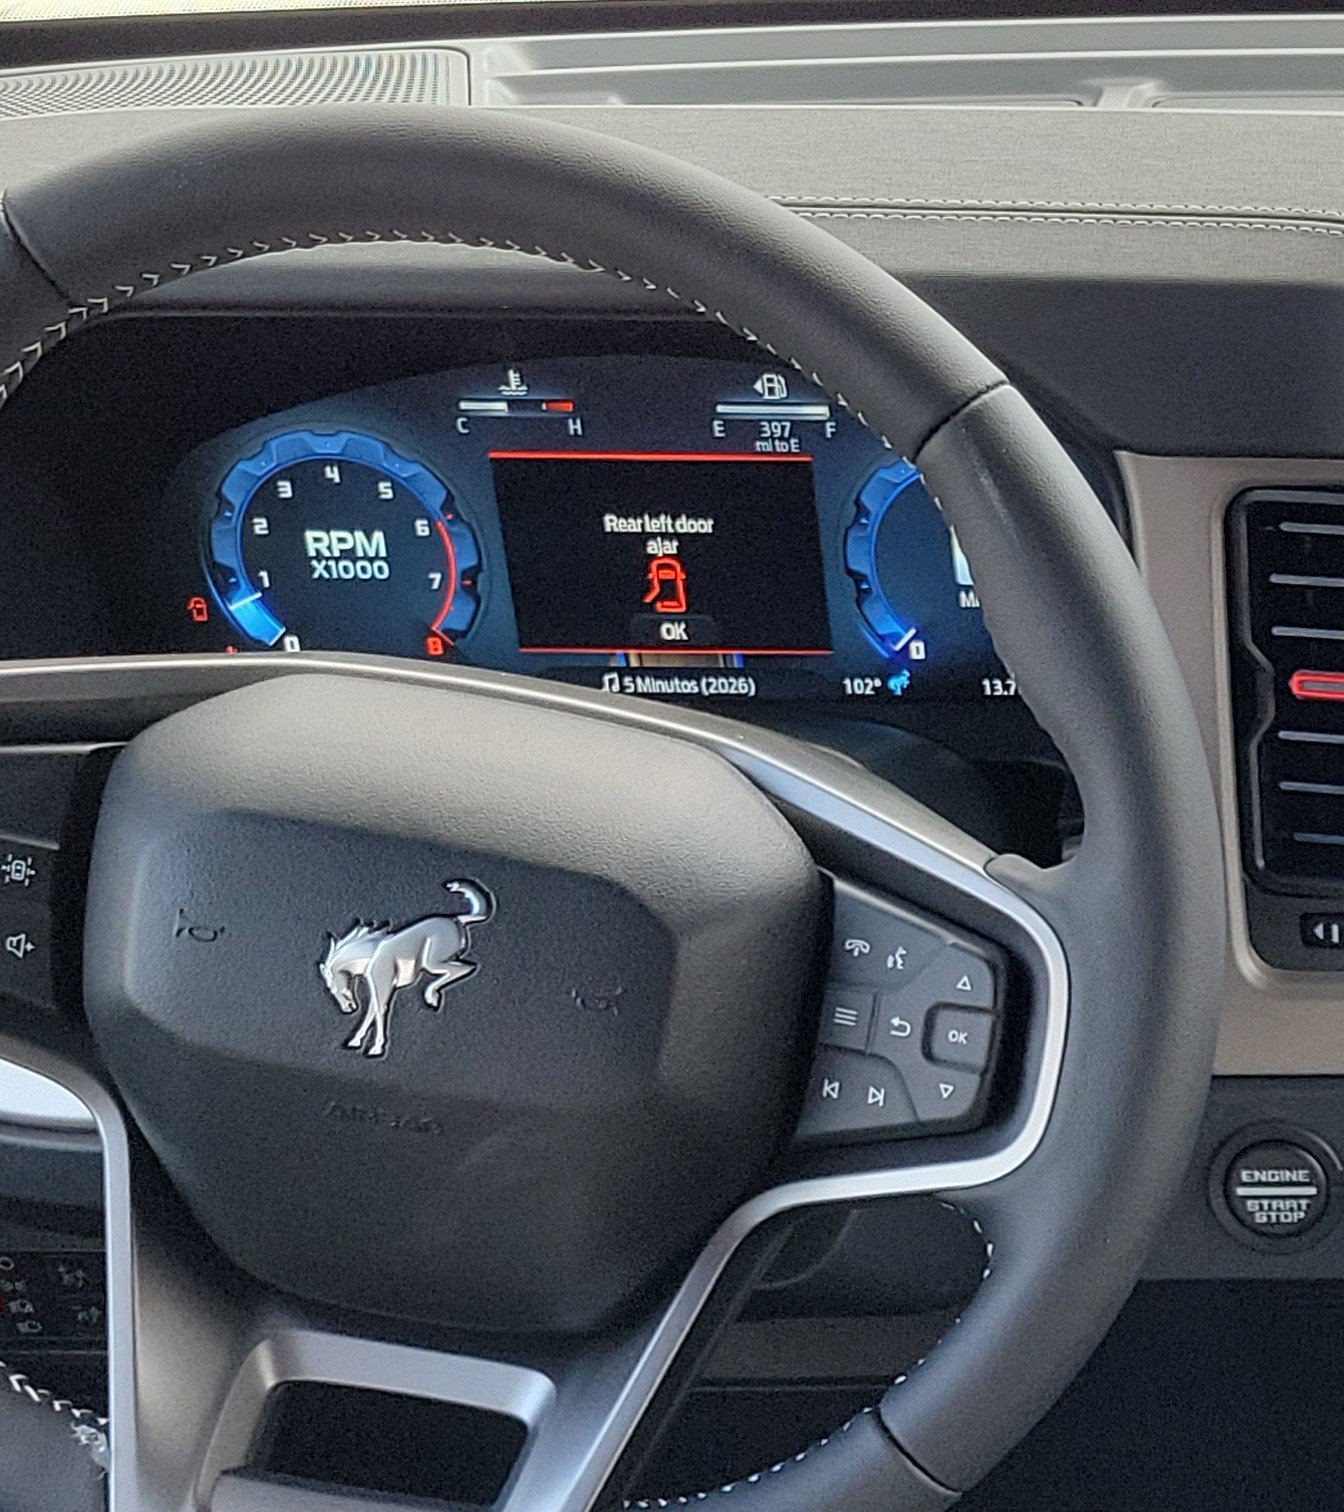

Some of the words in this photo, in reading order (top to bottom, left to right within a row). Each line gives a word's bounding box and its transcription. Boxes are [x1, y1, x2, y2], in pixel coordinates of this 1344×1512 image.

[456, 416, 470, 435] C
[567, 417, 583, 436] H
[712, 419, 726, 438] E
[760, 421, 791, 438] 397
[826, 422, 837, 438] F
[324, 465, 341, 484] 4
[276, 480, 293, 499] 3
[377, 482, 394, 500] 5
[251, 517, 270, 536] 2
[414, 519, 431, 538] 6
[603, 513, 643, 534] Rear
[643, 513, 674, 534] left
[674, 514, 715, 534] door
[303, 530, 388, 558] RPM
[646, 537, 679, 556] ajar
[258, 570, 271, 588] 1
[310, 560, 390, 580] X1000
[428, 573, 442, 590] 7
[660, 622, 689, 641] OK
[426, 637, 444, 655] 8
[909, 640, 926, 660] 0
[623, 676, 635, 694] 5
[636, 676, 699, 695] Minutos
[700, 677, 756, 697] (2026)
[843, 678, 882, 696] 102°
[982, 679, 1017, 696] 13.7
[948, 1030, 968, 1045] OK
[1240, 1169, 1311, 1183] ENGINE
[1246, 1200, 1311, 1212] START
[1253, 1211, 1306, 1224] STOP
